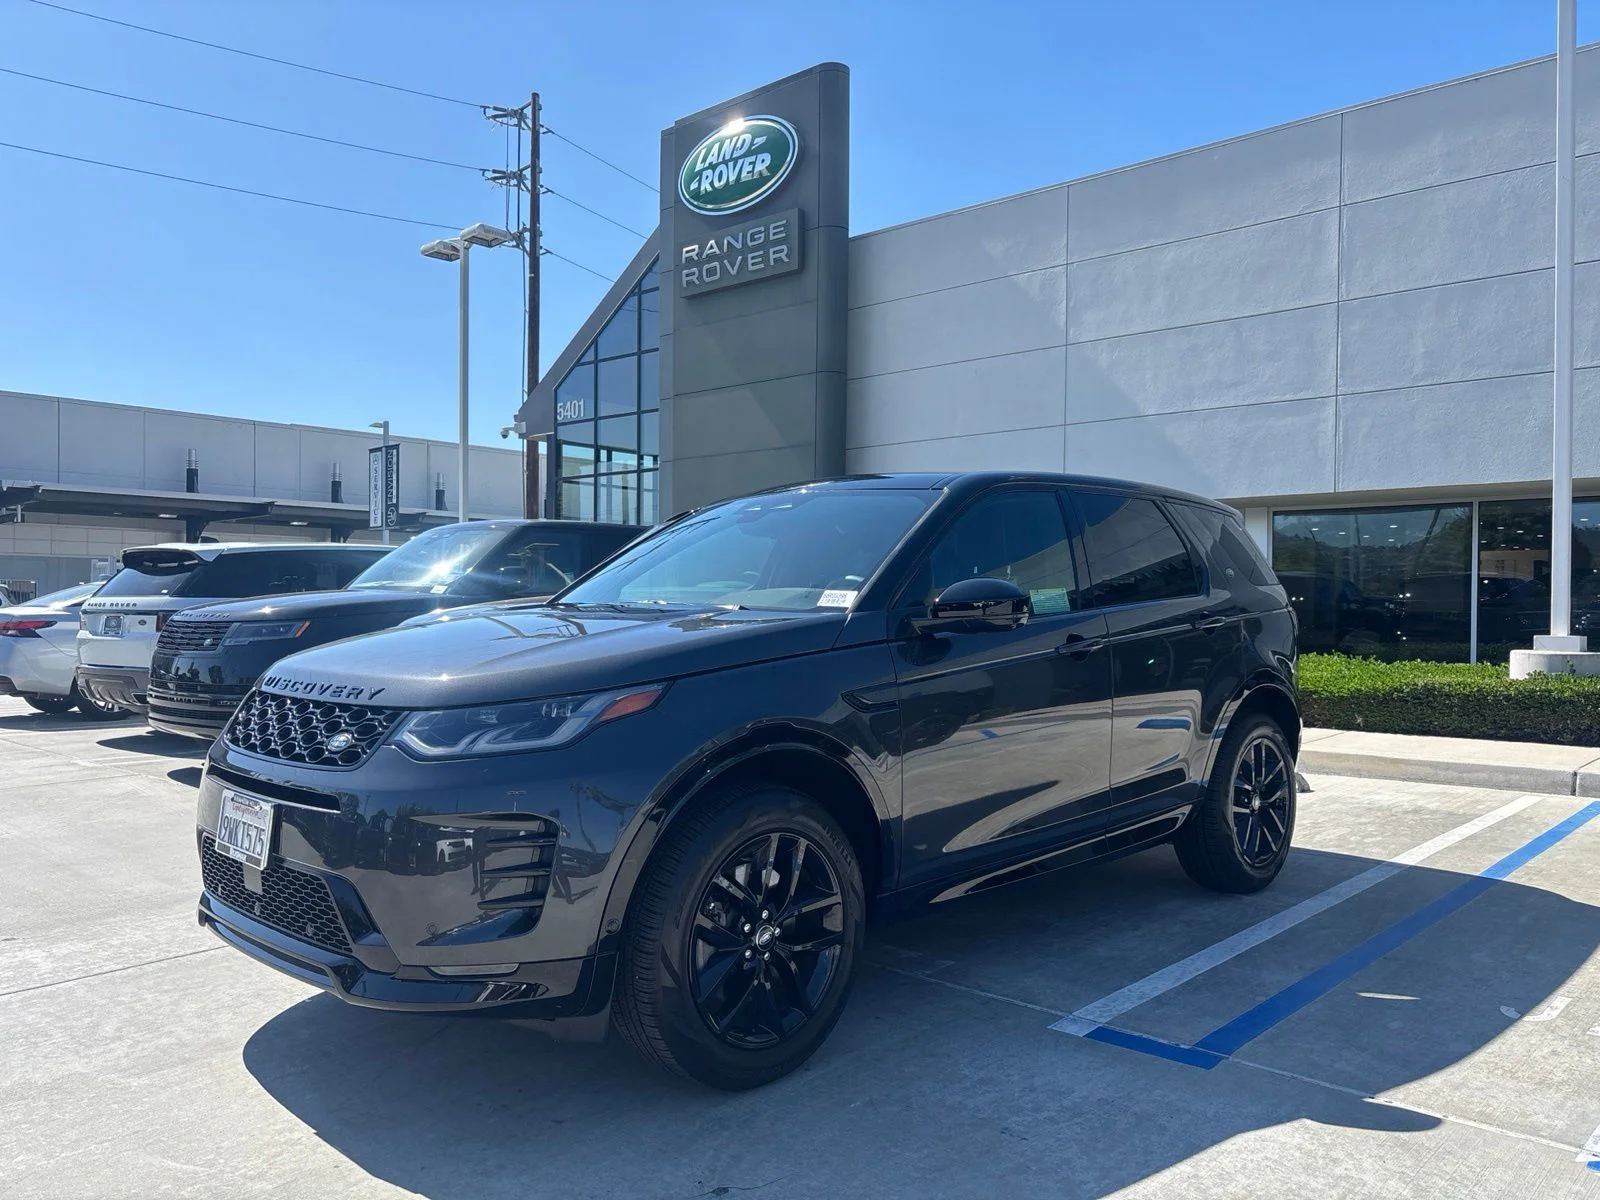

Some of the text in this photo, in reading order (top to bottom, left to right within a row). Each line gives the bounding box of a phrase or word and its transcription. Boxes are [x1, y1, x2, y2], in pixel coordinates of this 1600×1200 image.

[695, 134, 752, 172] LAND
[699, 153, 772, 195] ROVER
[681, 219, 788, 264] RANGE
[681, 244, 790, 288] ROVER
[556, 398, 584, 421] 5401
[263, 675, 386, 701] DISCOVERY
